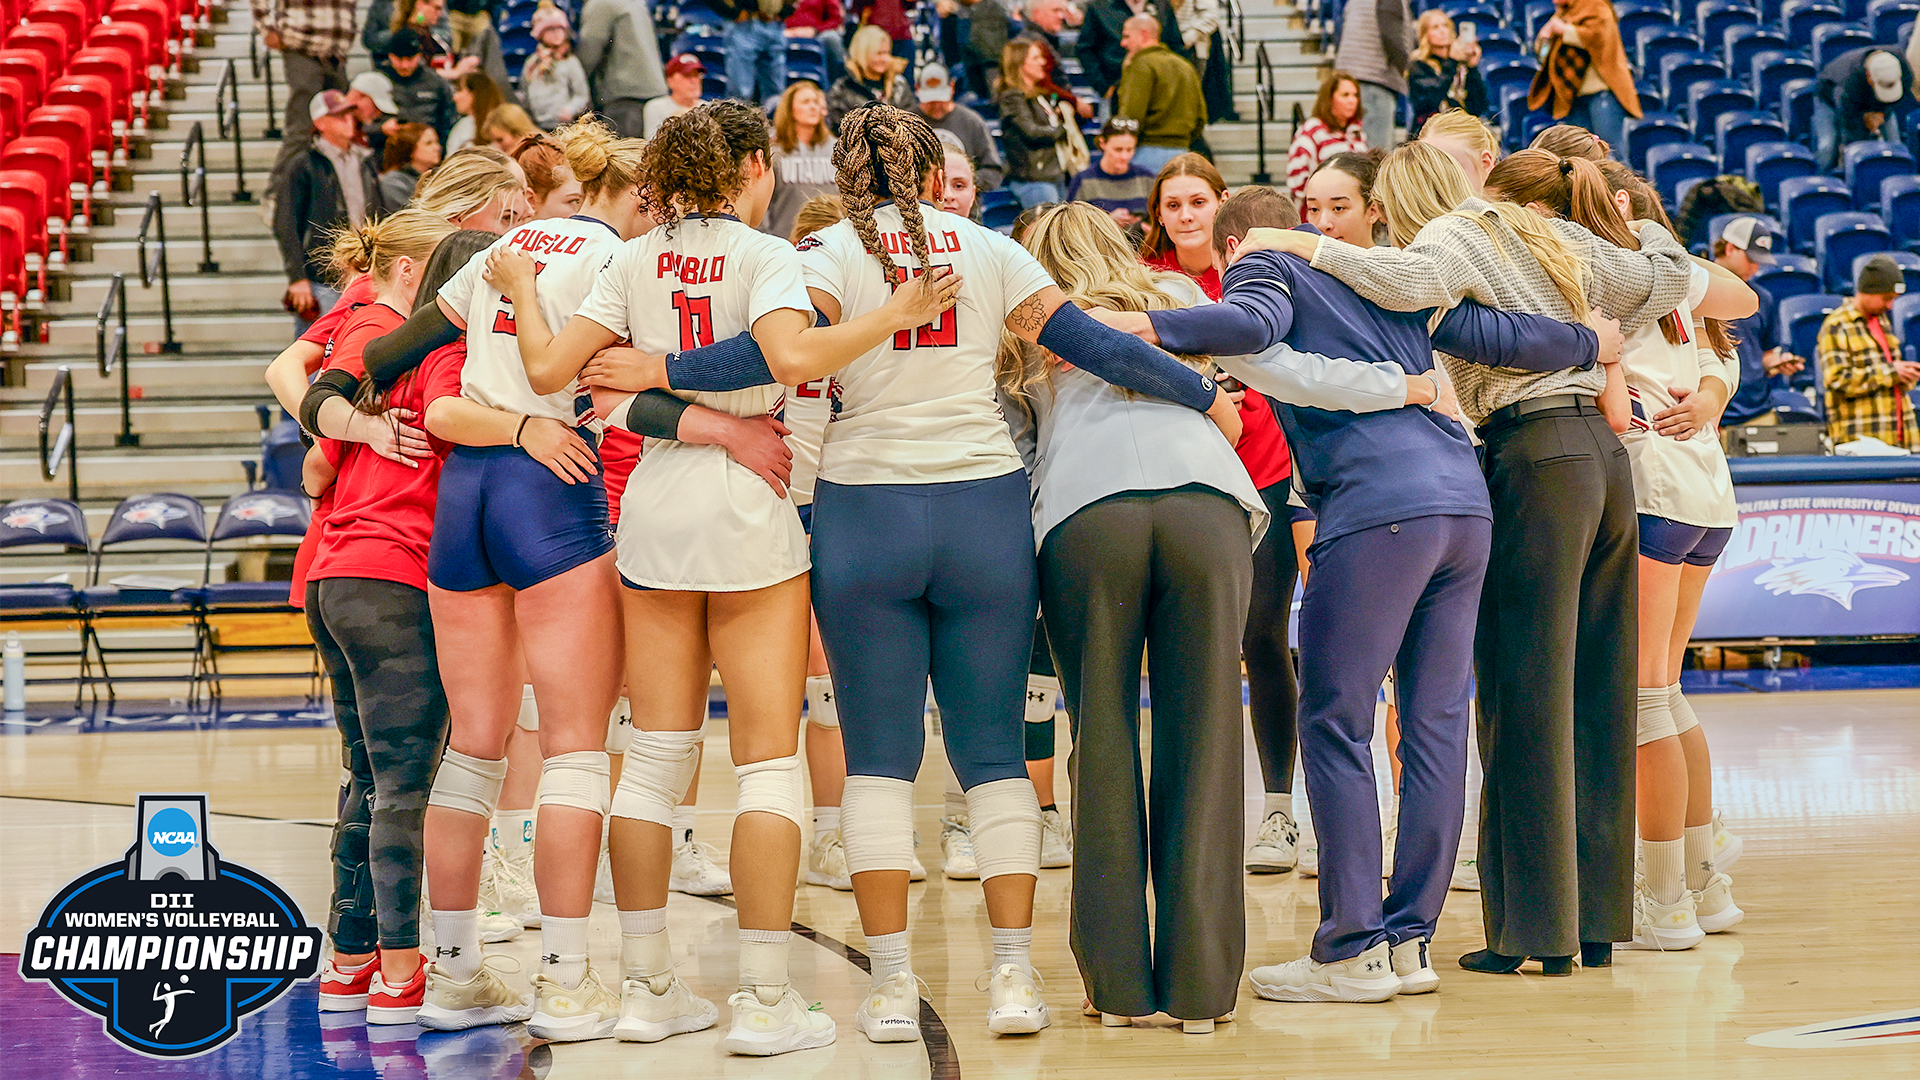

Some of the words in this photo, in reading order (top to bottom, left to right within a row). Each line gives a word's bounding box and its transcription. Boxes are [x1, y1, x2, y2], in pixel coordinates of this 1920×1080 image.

[866, 230, 961, 256] UELO
[1780, 497, 1811, 510] STATE
[1812, 497, 1873, 511] UNIVERSITY
[1873, 499, 1887, 511] OF
[1888, 500, 1920, 516] DENVE
